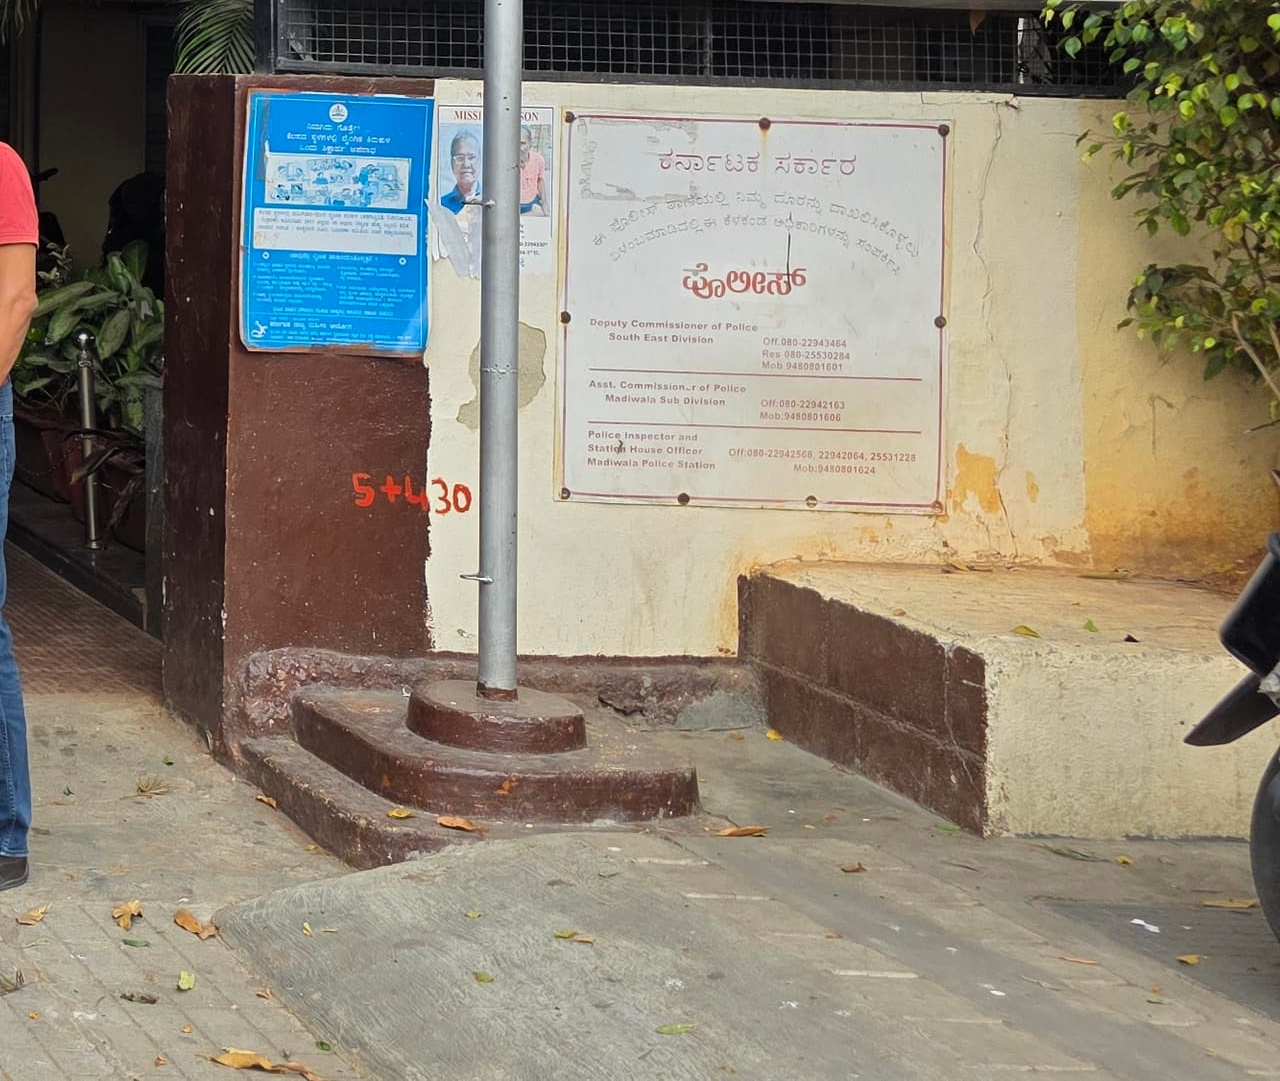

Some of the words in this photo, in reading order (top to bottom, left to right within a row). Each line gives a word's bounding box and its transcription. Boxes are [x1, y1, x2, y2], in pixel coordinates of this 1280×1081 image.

[454, 110, 482, 120] MISSI
[658, 149, 760, 174] ಕರ್ನಾಟಕ
[774, 153, 858, 176] ಸರ್ಕಾರ
[682, 262, 807, 300] ಪೊಲೀಸ್
[590, 318, 628, 330] Deputy
[631, 319, 708, 331] Commissioner
[711, 322, 722, 330] of
[725, 322, 758, 332] Police
[609, 332, 641, 343] South
[644, 333, 668, 344] East
[671, 334, 714, 345] Division
[589, 380, 617, 390] Asst.
[620, 381, 696, 392] Commissionr
[699, 384, 711, 393] of
[713, 384, 746, 394] Police
[605, 394, 657, 405] Madiwala
[660, 395, 681, 406] Sub
[683, 396, 726, 407] Division
[588, 430, 621, 441] Police
[624, 431, 676, 443] Inspector
[678, 432, 699, 442] and
[630, 444, 664, 455] House
[666, 445, 704, 456] Officer
[587, 458, 639, 468] Madiwala
[641, 459, 674, 469] Police
[677, 460, 716, 471] Station
